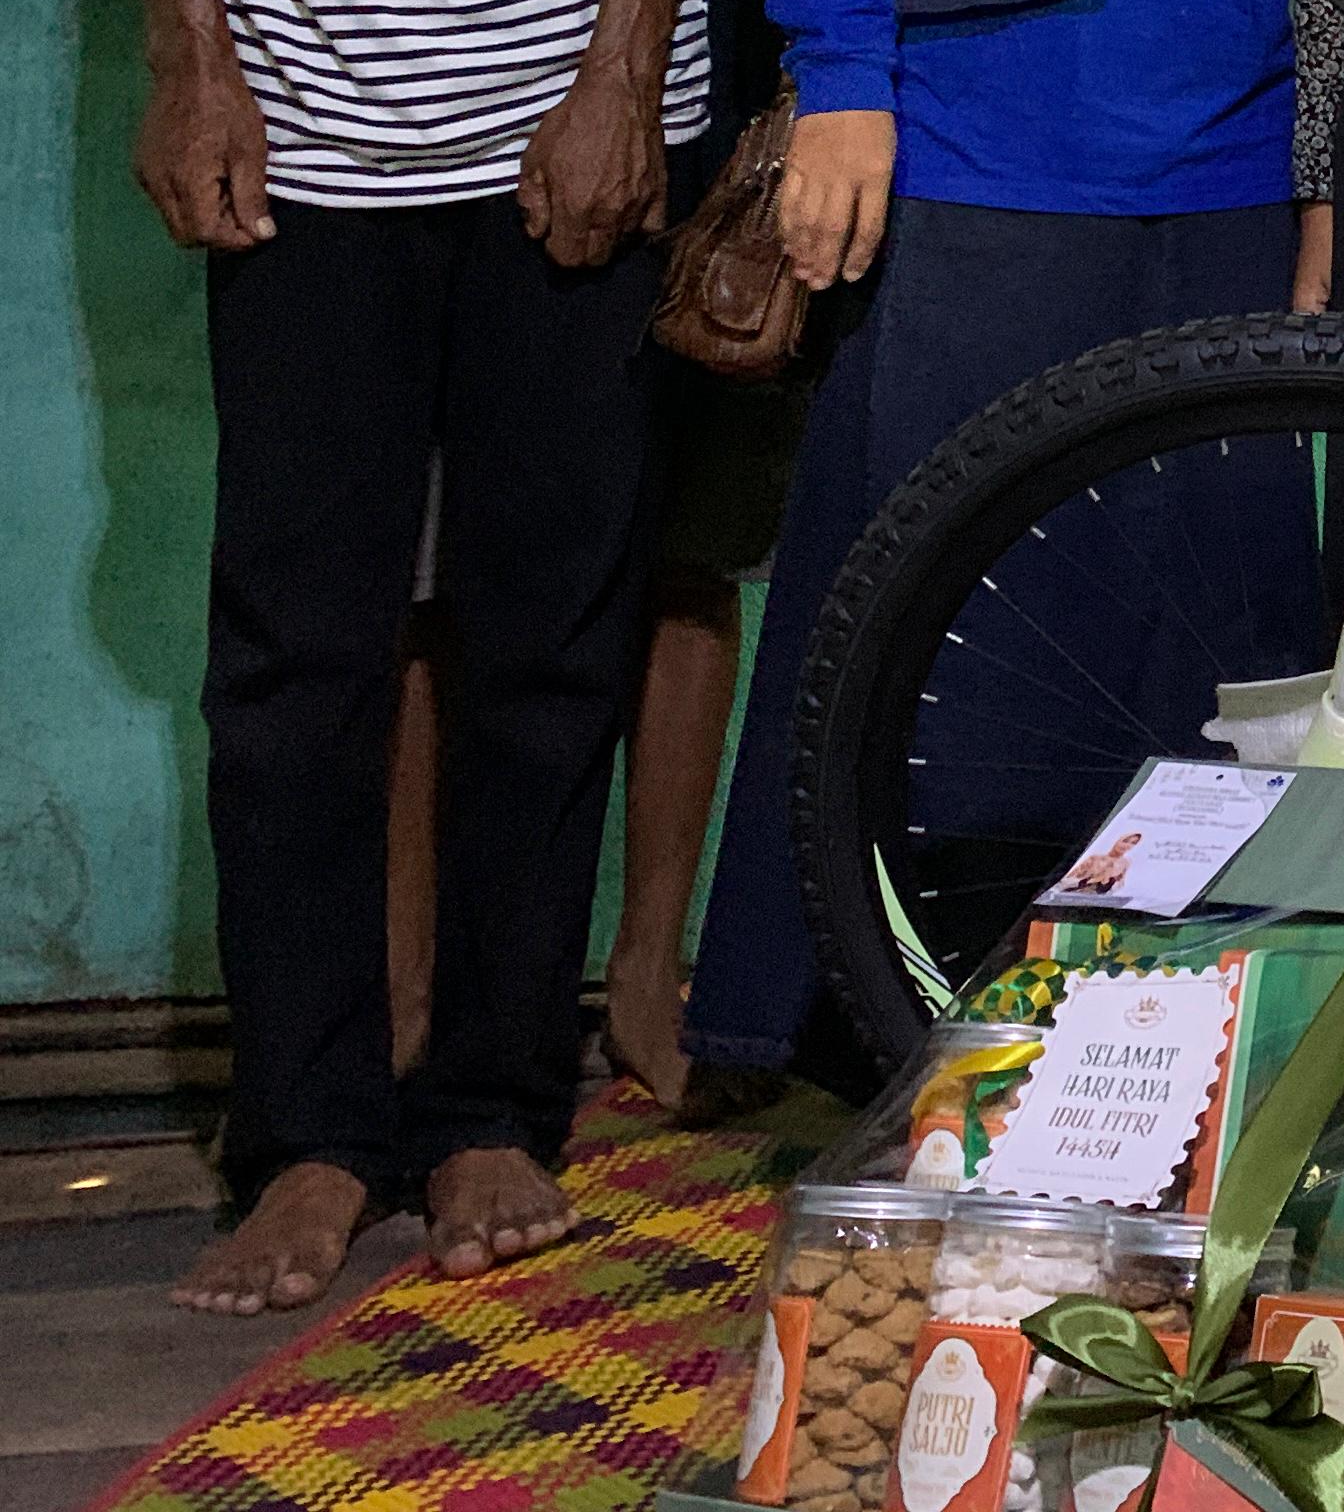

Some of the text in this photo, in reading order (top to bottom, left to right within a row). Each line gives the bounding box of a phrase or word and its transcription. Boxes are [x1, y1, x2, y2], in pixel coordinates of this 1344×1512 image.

[1080, 1043, 1180, 1071] SELAMAT
[1061, 1074, 1171, 1104] HARI RAYA
[1048, 1106, 1159, 1138] IDUL FITRI
[1056, 1136, 1122, 1160] 1445H
[917, 1391, 975, 1429] PUTRI
[908, 1423, 969, 1457] SALJU
